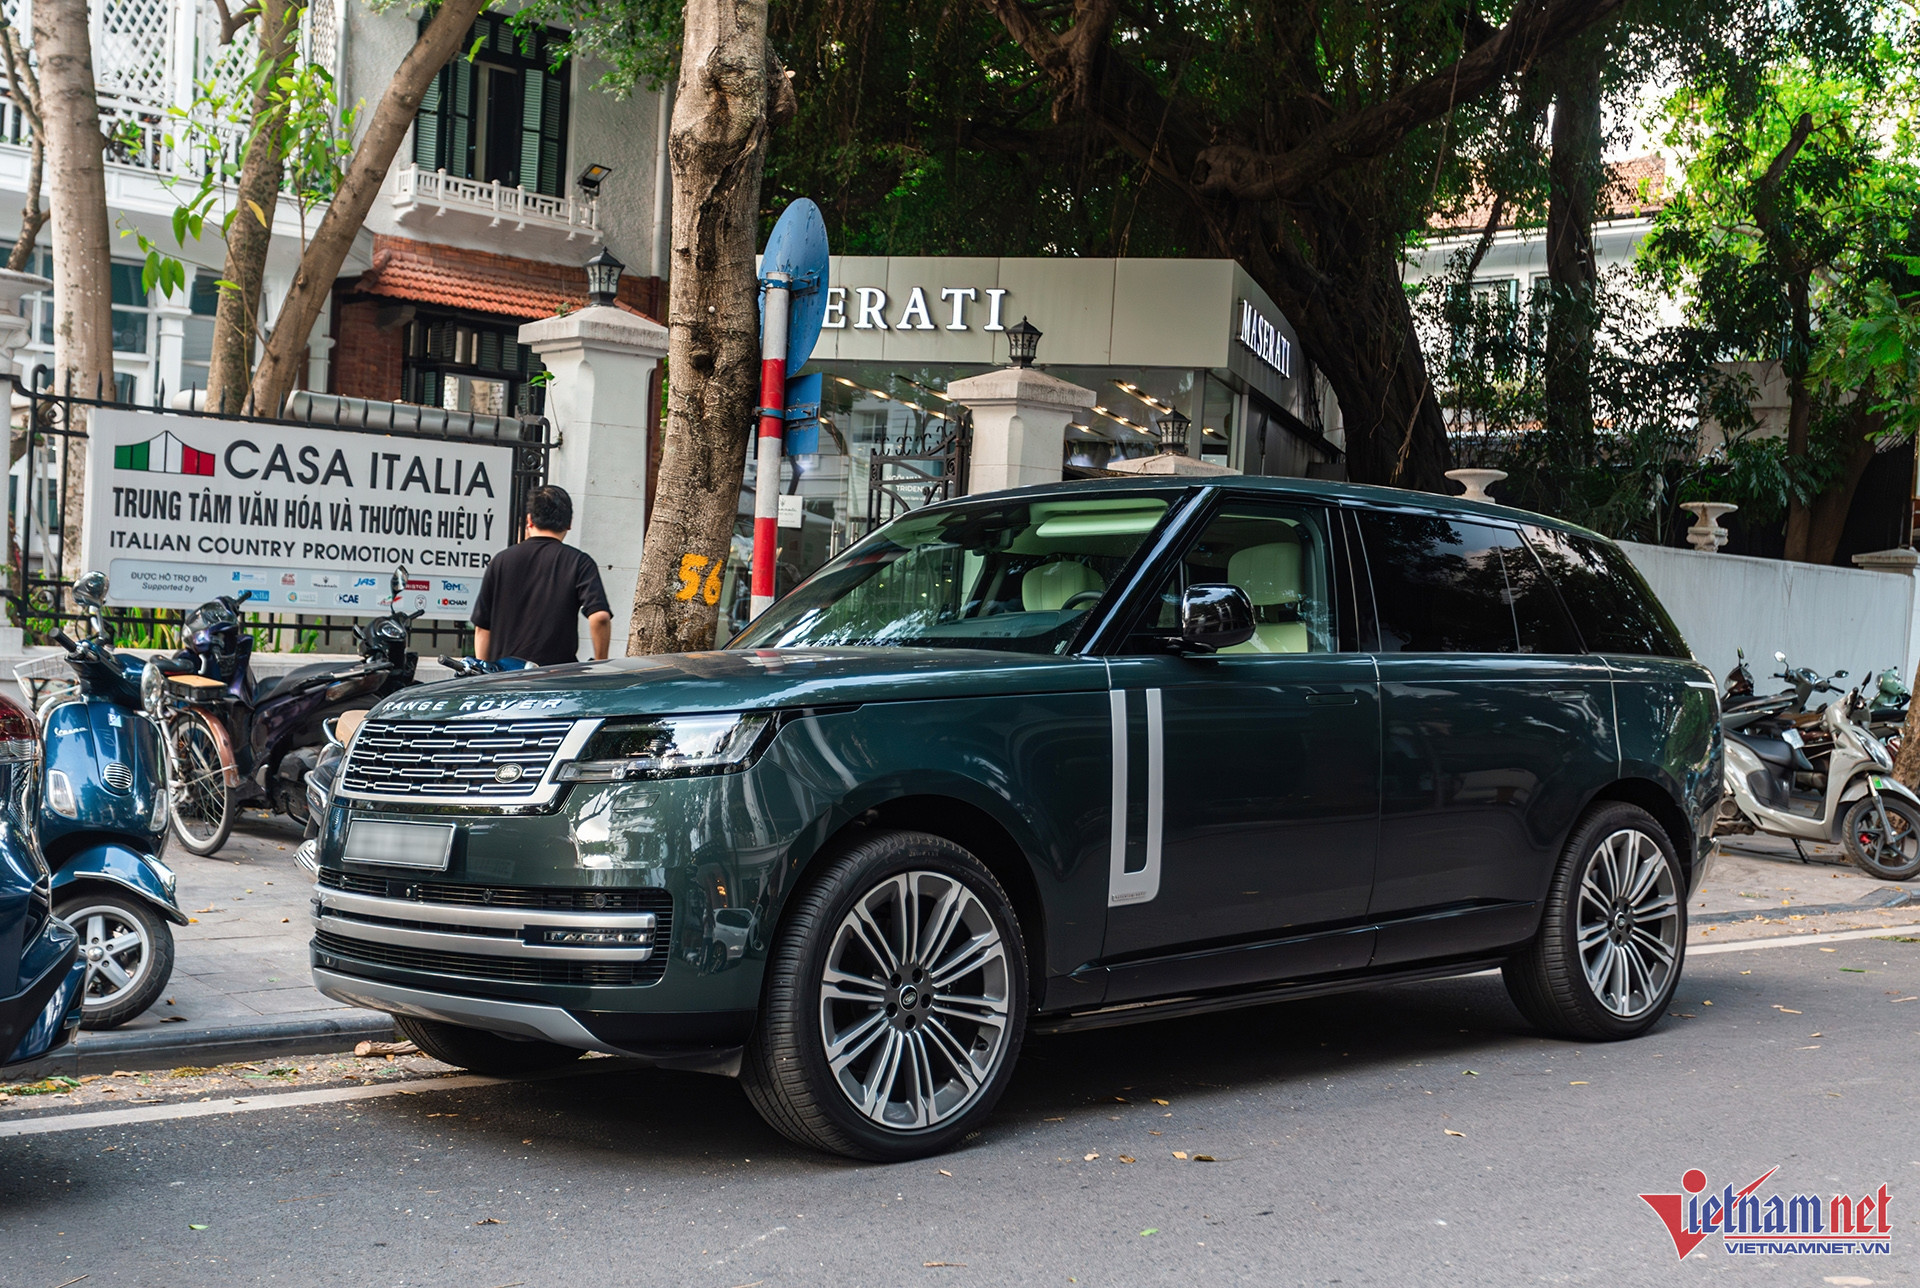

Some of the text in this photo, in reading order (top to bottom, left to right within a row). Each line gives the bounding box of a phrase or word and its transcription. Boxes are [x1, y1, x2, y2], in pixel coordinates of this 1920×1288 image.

[822, 287, 1007, 332] ERATI
[1240, 299, 1291, 378] MASERATI
[224, 439, 495, 498] CASA ITALIA
[113, 487, 494, 545] TRUNG TÂM VĂN HÓA VÀ THƯƠNG HIỆU Ý
[110, 530, 491, 569] ITALIAN COUNTRY PROMOTION CENTER
[142, 582, 195, 593] Supported by
[354, 577, 376, 587] JAS
[675, 553, 723, 606] 56
[382, 699, 563, 712] RANGE ROVER
